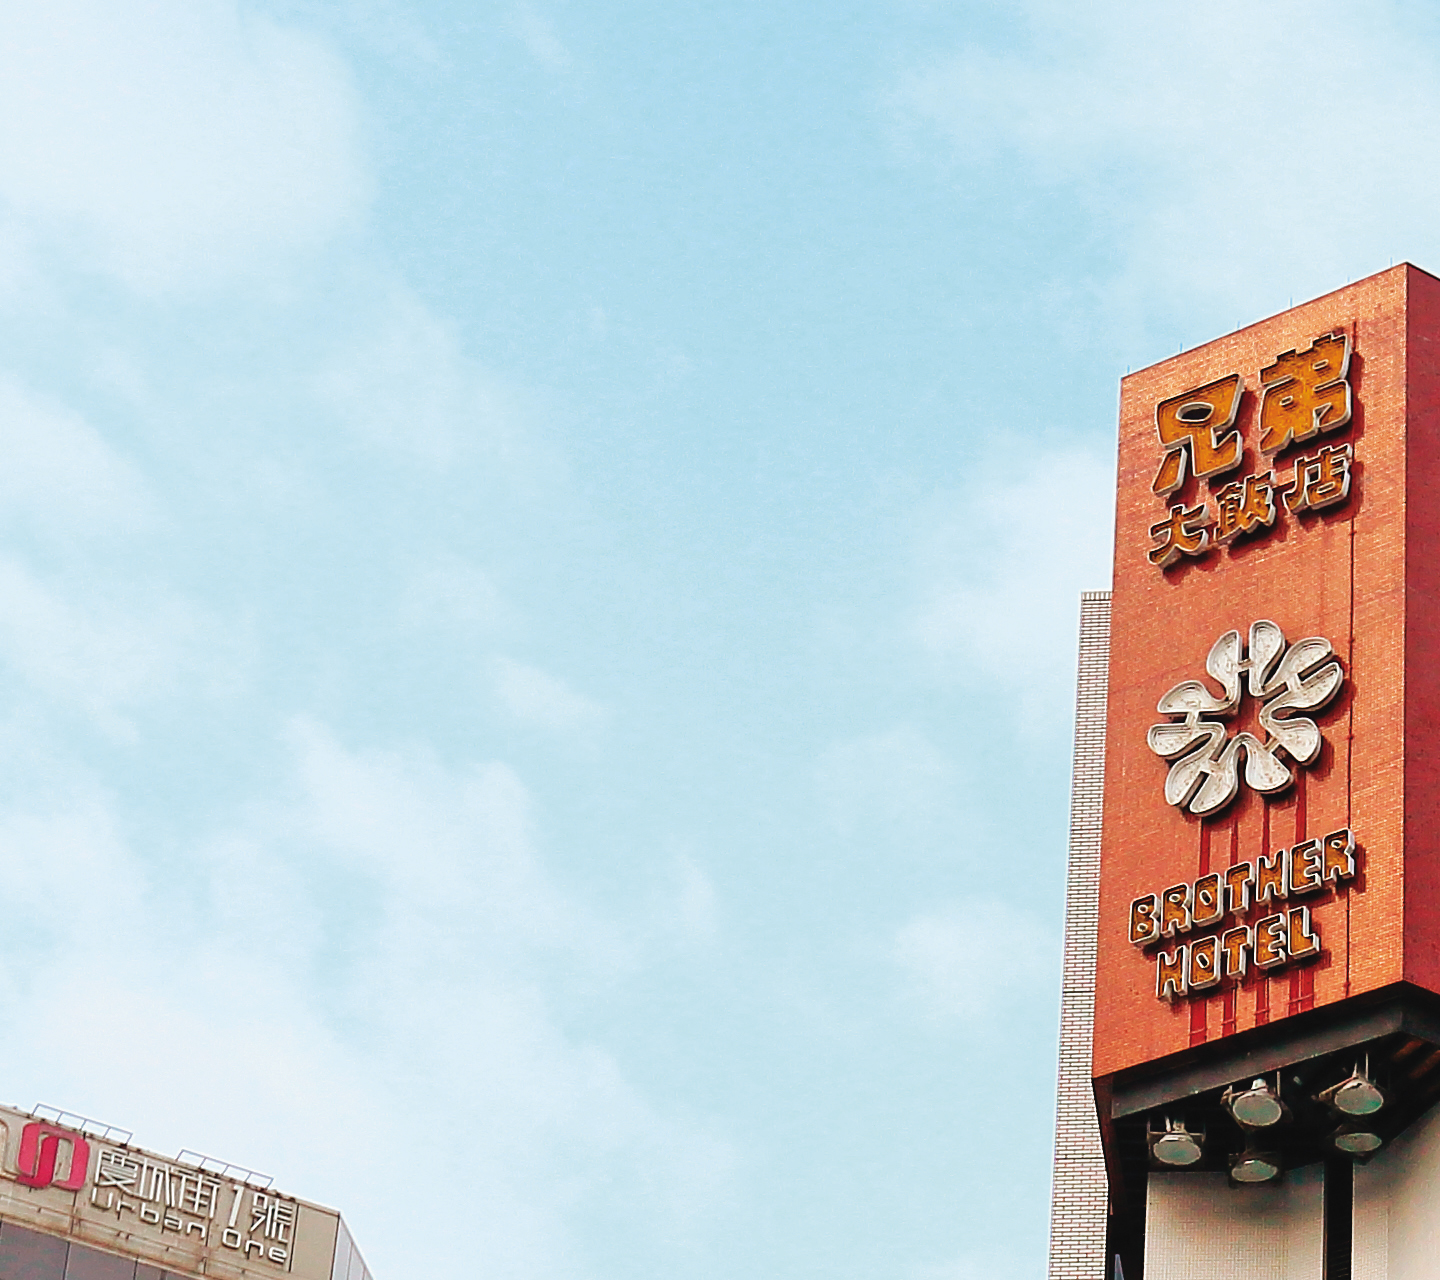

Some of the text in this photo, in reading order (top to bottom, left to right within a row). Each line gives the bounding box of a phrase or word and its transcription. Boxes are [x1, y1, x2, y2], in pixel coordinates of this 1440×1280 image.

[1151, 333, 1352, 497] 兄弟
[1147, 443, 1353, 569] 大飯店
[1129, 828, 1355, 947] BROTHER
[1156, 906, 1320, 1001] HOTEL
